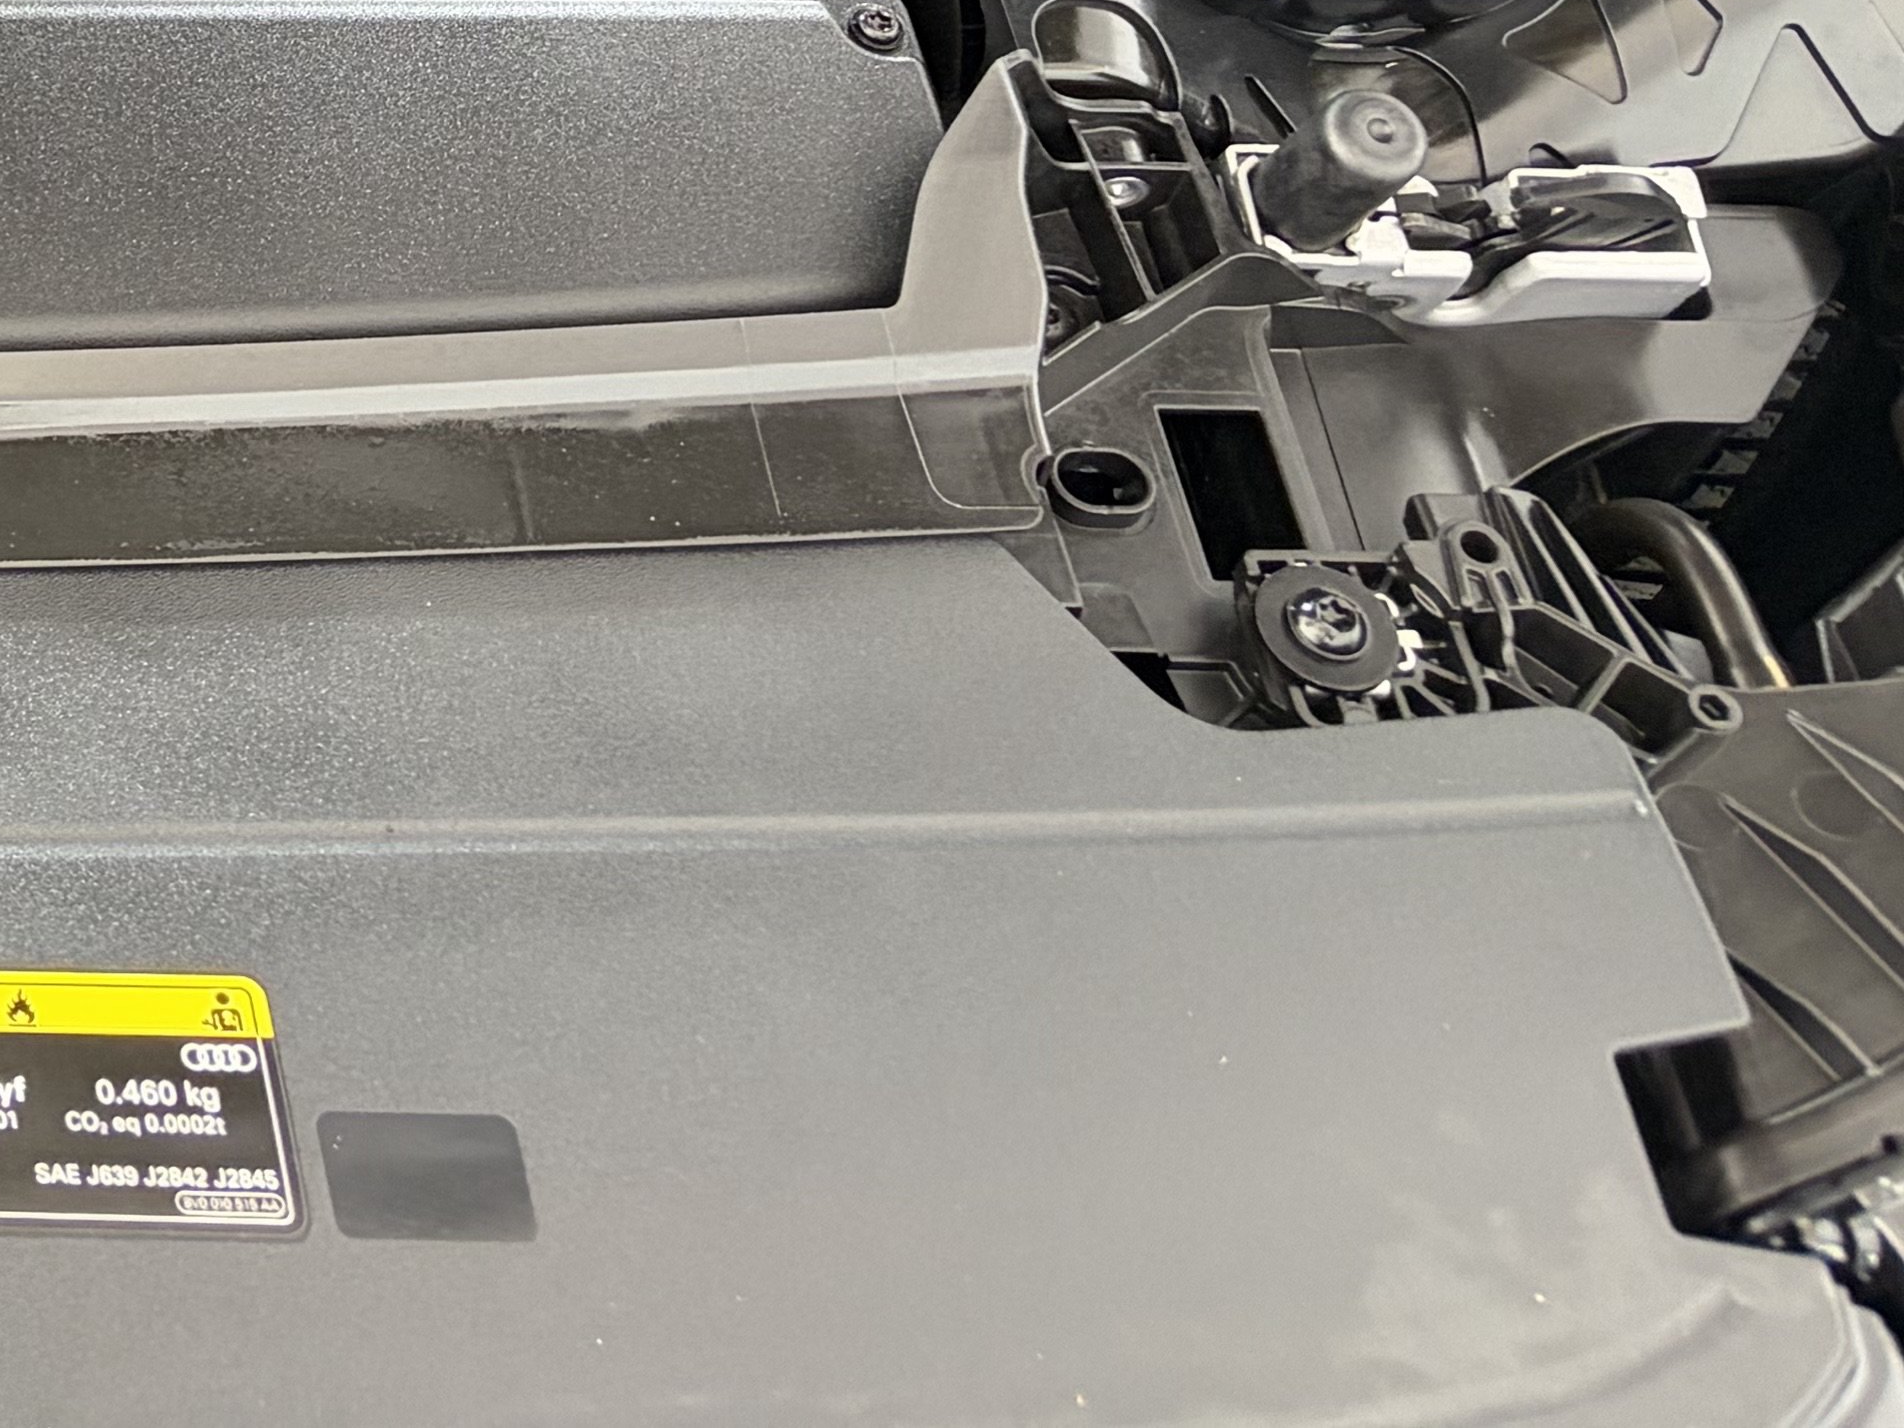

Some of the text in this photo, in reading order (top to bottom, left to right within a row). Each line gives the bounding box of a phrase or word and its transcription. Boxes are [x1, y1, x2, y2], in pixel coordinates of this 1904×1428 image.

[95, 1078, 222, 1113] 0.460 kg
[111, 1115, 142, 1137] eq
[145, 1113, 227, 1136] 0.0002t
[34, 1162, 280, 1190] SAE J639 J2842 J2845
